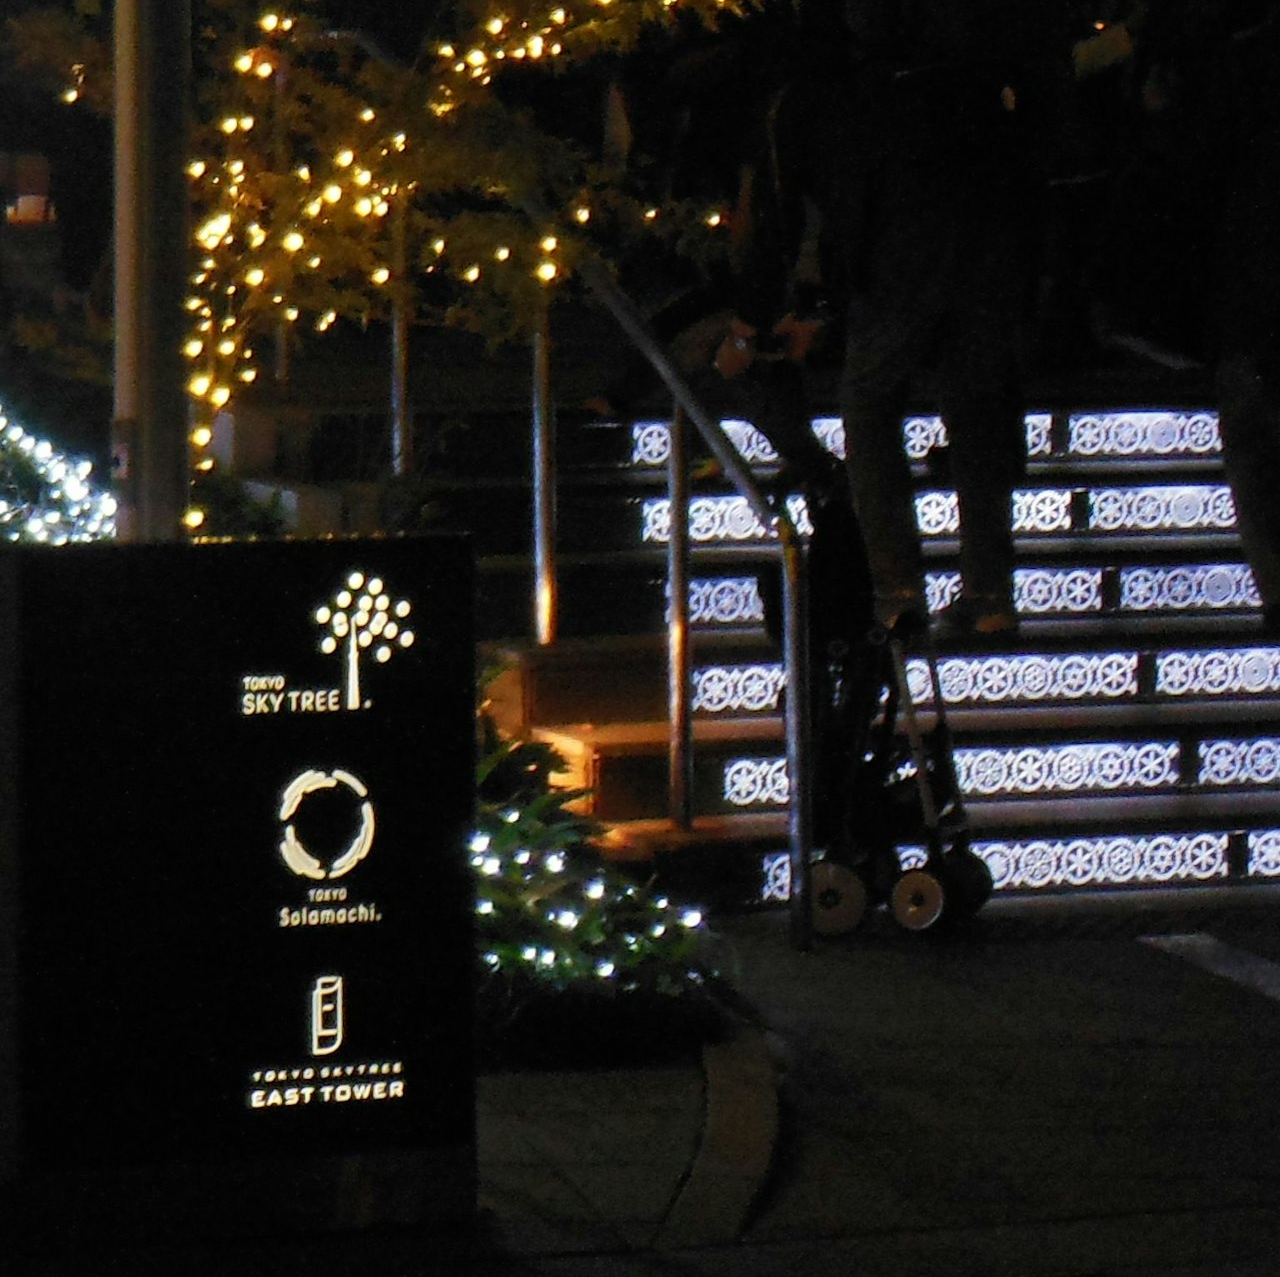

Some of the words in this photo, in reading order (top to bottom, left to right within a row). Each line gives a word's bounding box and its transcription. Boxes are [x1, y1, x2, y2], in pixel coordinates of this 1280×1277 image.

[242, 675, 286, 692] TOKYO
[242, 692, 285, 716] SKY
[287, 688, 340, 712] TREE
[308, 887, 348, 903] TOKYO
[252, 1067, 315, 1083] TOKYO
[250, 1086, 315, 1108] EAST
[319, 1080, 405, 1102] TOWER
